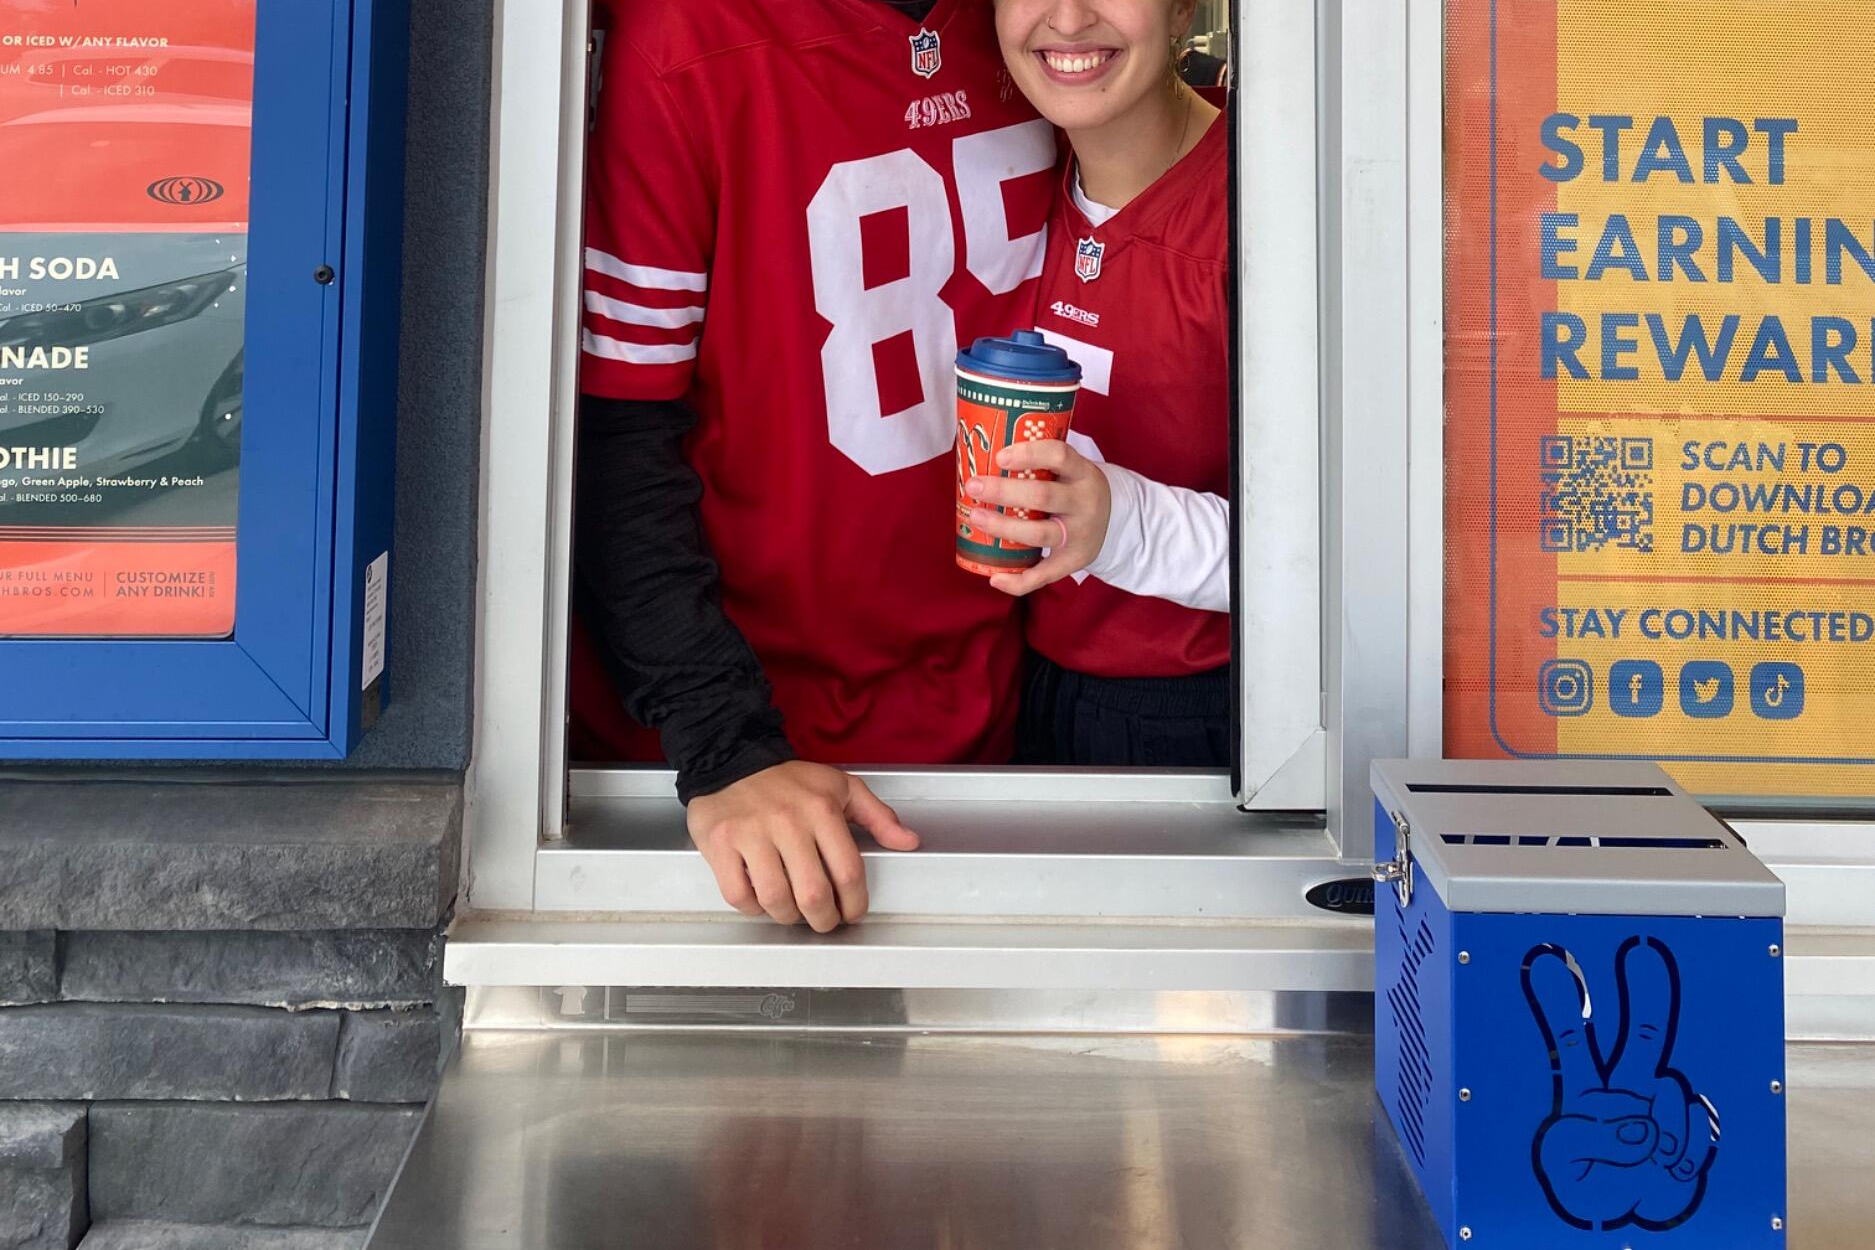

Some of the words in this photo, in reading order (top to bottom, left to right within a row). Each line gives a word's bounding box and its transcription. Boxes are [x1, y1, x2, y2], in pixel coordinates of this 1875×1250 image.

[2, 35, 22, 46] OR
[26, 36, 55, 47] ICED
[59, 36, 113, 49] W/ANY
[116, 37, 168, 48] FLAVOR
[106, 65, 131, 75] HOT
[134, 66, 158, 77] 430
[104, 85, 131, 96] ICED
[135, 85, 155, 96] 310
[904, 89, 972, 130] 49ERS
[1538, 112, 1799, 185] START
[1540, 212, 1875, 285] EARNIN
[0, 257, 19, 279] H
[29, 257, 120, 280] SODA
[807, 119, 1057, 475] 85
[21, 303, 43, 312] ICED
[1050, 301, 1100, 327] 49ERS
[1540, 312, 1875, 384] REWAR
[1, 346, 89, 369] NADE
[18, 393, 40, 402] ICED
[18, 405, 60, 414] BLENDED
[1680, 440, 1786, 472] SCAN
[1797, 442, 1848, 473] TO
[0, 478, 18, 488] go,
[21, 476, 55, 486] Green
[57, 475, 93, 489] Apple,
[96, 476, 157, 489] Strawberry
[159, 476, 168, 486] &
[171, 475, 204, 486] Peach
[16, 493, 58, 502] BLENDED
[1680, 523, 1809, 555] DUTCH
[1821, 525, 1875, 556] BR
[18, 571, 48, 581] FULL
[54, 571, 94, 582] MENU
[116, 572, 206, 583] CUSTOMIZE
[116, 586, 149, 597] ANY
[153, 586, 205, 598] DRINK!
[1538, 607, 1627, 639] STAY
[1639, 609, 1875, 642] CONNECTED
